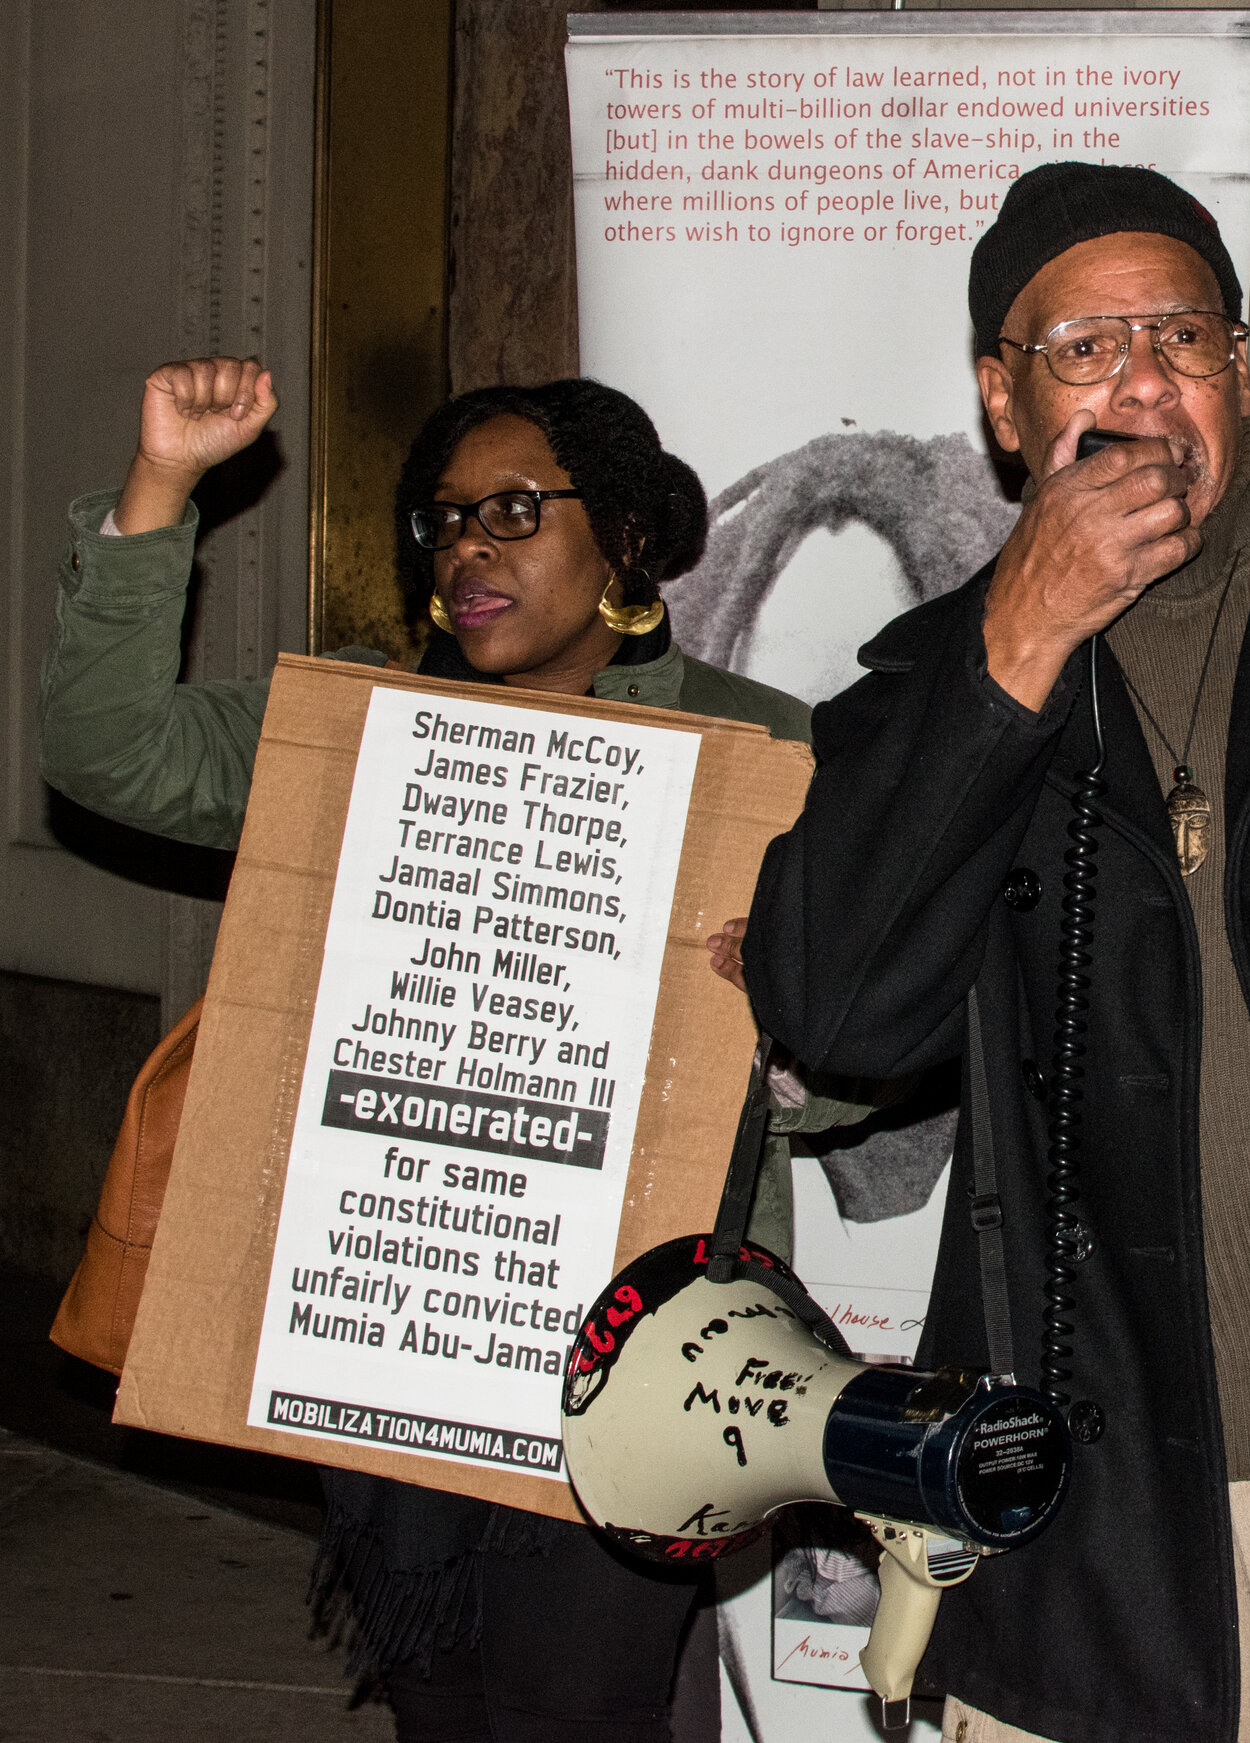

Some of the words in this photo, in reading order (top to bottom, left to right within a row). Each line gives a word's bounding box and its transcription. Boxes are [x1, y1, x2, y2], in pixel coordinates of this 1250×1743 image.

[606, 101, 682, 120] towers
[692, 98, 716, 119] of
[725, 98, 872, 119] multi-billion
[882, 97, 947, 118] dollar
[958, 96, 1064, 118] endowed
[1075, 97, 1210, 118] universities
[673, 68, 690, 88] is
[701, 69, 737, 88] the
[747, 71, 804, 93] story
[813, 67, 838, 88] of
[847, 67, 884, 88] law
[894, 66, 986, 90] learned,
[998, 69, 1036, 87] not
[1046, 68, 1066, 87] in
[1077, 66, 1113, 87] the
[1123, 67, 1180, 90] ivory
[607, 130, 657, 153] [but]
[668, 131, 688, 150] in
[698, 130, 734, 150] the
[745, 129, 825, 150] bowels
[834, 128, 859, 150] of
[867, 128, 902, 149] the
[912, 128, 1042, 152] slave-ship,
[1053, 129, 1073, 148] in
[1084, 128, 1121, 149] the
[605, 160, 691, 182] hidden,
[702, 160, 759, 181] dank
[768, 160, 883, 185] dungeons
[893, 158, 916, 180] of
[923, 160, 1020, 180] America
[605, 191, 673, 211] where
[684, 191, 774, 211] millions
[785, 190, 809, 211] of
[817, 190, 894, 216] people
[904, 190, 949, 212] live,
[960, 190, 998, 211] but
[605, 222, 676, 242] others
[686, 221, 739, 242] wish
[748, 224, 771, 242] to
[780, 222, 855, 247] ignore
[864, 226, 887, 242] or
[413, 711, 535, 754] Sherman
[547, 730, 644, 775] McCoy,
[415, 749, 508, 787] James
[520, 763, 628, 810] Frazier,
[403, 783, 507, 825] Dwayne
[524, 801, 627, 848] Thorpe,
[399, 819, 523, 864] Terrance
[535, 840, 622, 884] Lewis,
[379, 856, 480, 896] Jamaal
[492, 872, 626, 923] Simmons,
[372, 890, 461, 931] Dontia
[473, 906, 620, 960] Patterson,
[411, 938, 480, 974] John
[493, 949, 570, 992] Miller,
[391, 971, 456, 1007] Willie
[473, 983, 578, 1031] Veasey,
[352, 1005, 456, 1051] Johnny
[468, 1021, 546, 1065] Berry
[558, 1041, 609, 1069] and
[334, 1038, 446, 1081] Chester
[456, 1057, 576, 1102] Holmann
[589, 1077, 615, 1108] III
[384, 1147, 430, 1182] for
[443, 1164, 527, 1197] same
[340, 1191, 560, 1246] constitutional
[329, 1230, 479, 1276] violations
[495, 1251, 560, 1289] that
[292, 1267, 411, 1314] unfairly
[424, 1289, 583, 1336] convicted
[289, 1302, 384, 1347] Mumia
[399, 1320, 573, 1377] Abu-Jamal
[273, 1397, 559, 1467] MOBILIZATION4MUMIA.COM
[722, 1425, 748, 1467] 9
[973, 1427, 1045, 1450] POWERHORN
[980, 1413, 1040, 1434] RadioShack
[777, 1635, 849, 1671] Mumia
